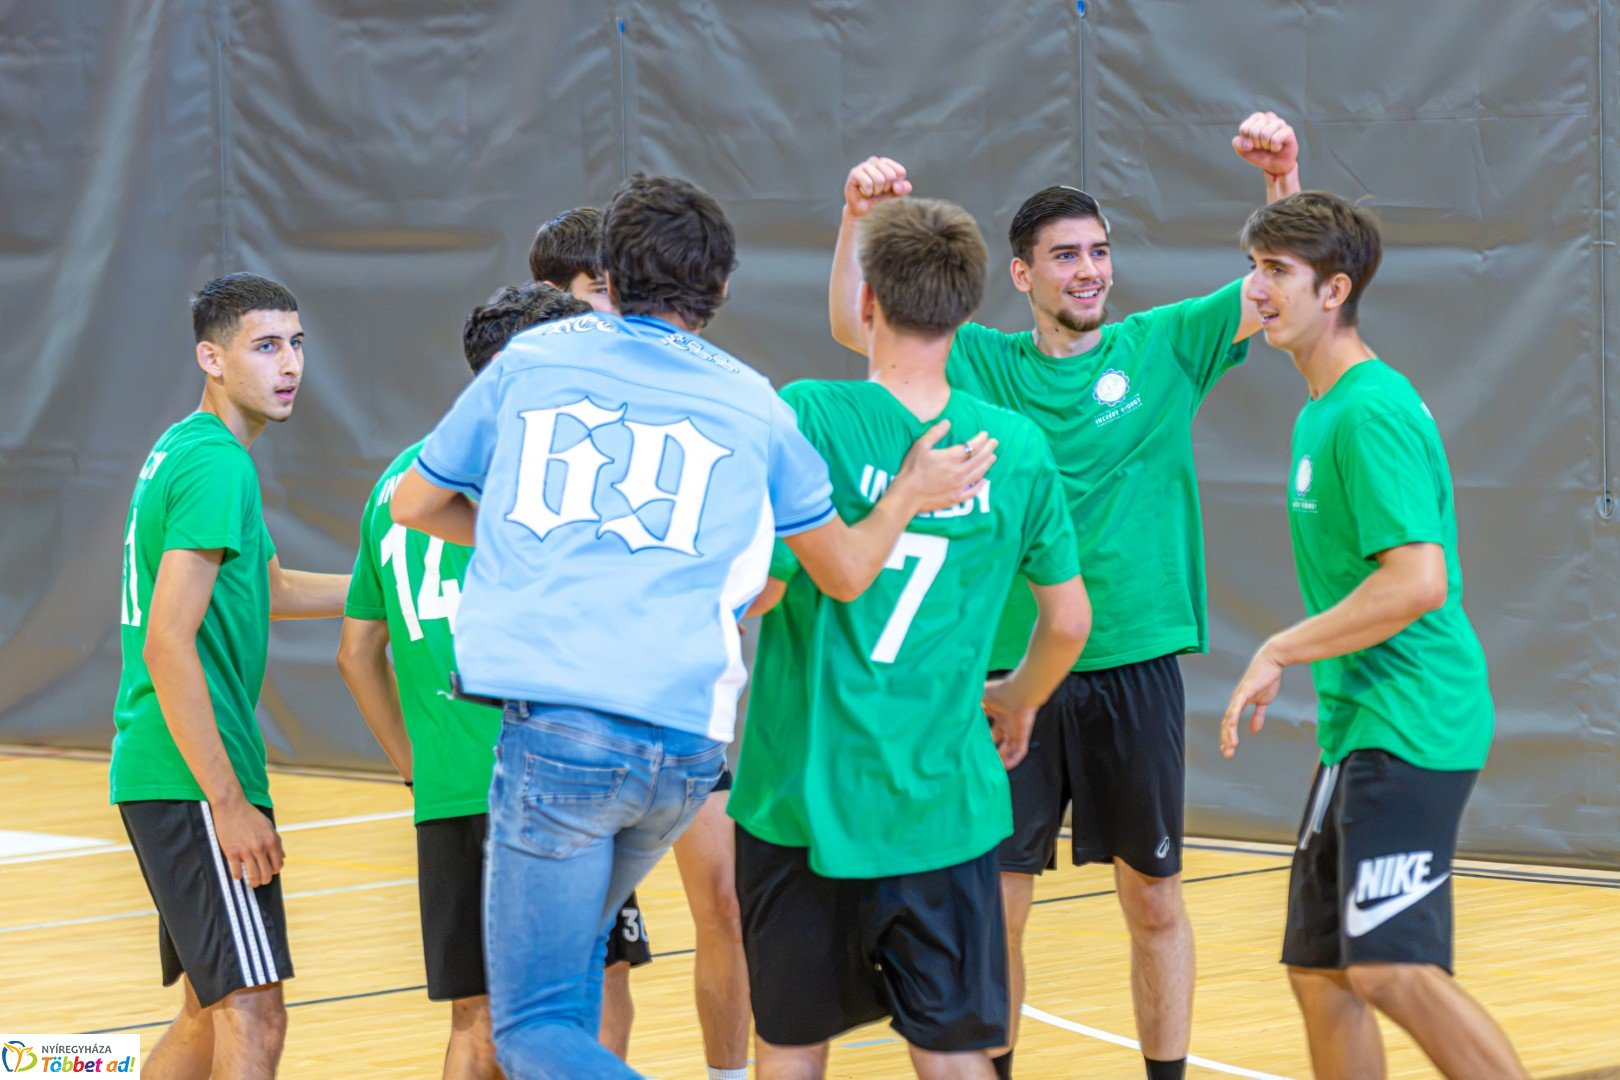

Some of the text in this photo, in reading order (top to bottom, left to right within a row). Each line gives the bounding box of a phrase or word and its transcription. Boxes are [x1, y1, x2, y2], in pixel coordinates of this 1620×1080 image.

[503, 395, 735, 558] 69
[381, 523, 462, 641] 14
[870, 531, 949, 664] 7
[1355, 850, 1434, 904] NIKE
